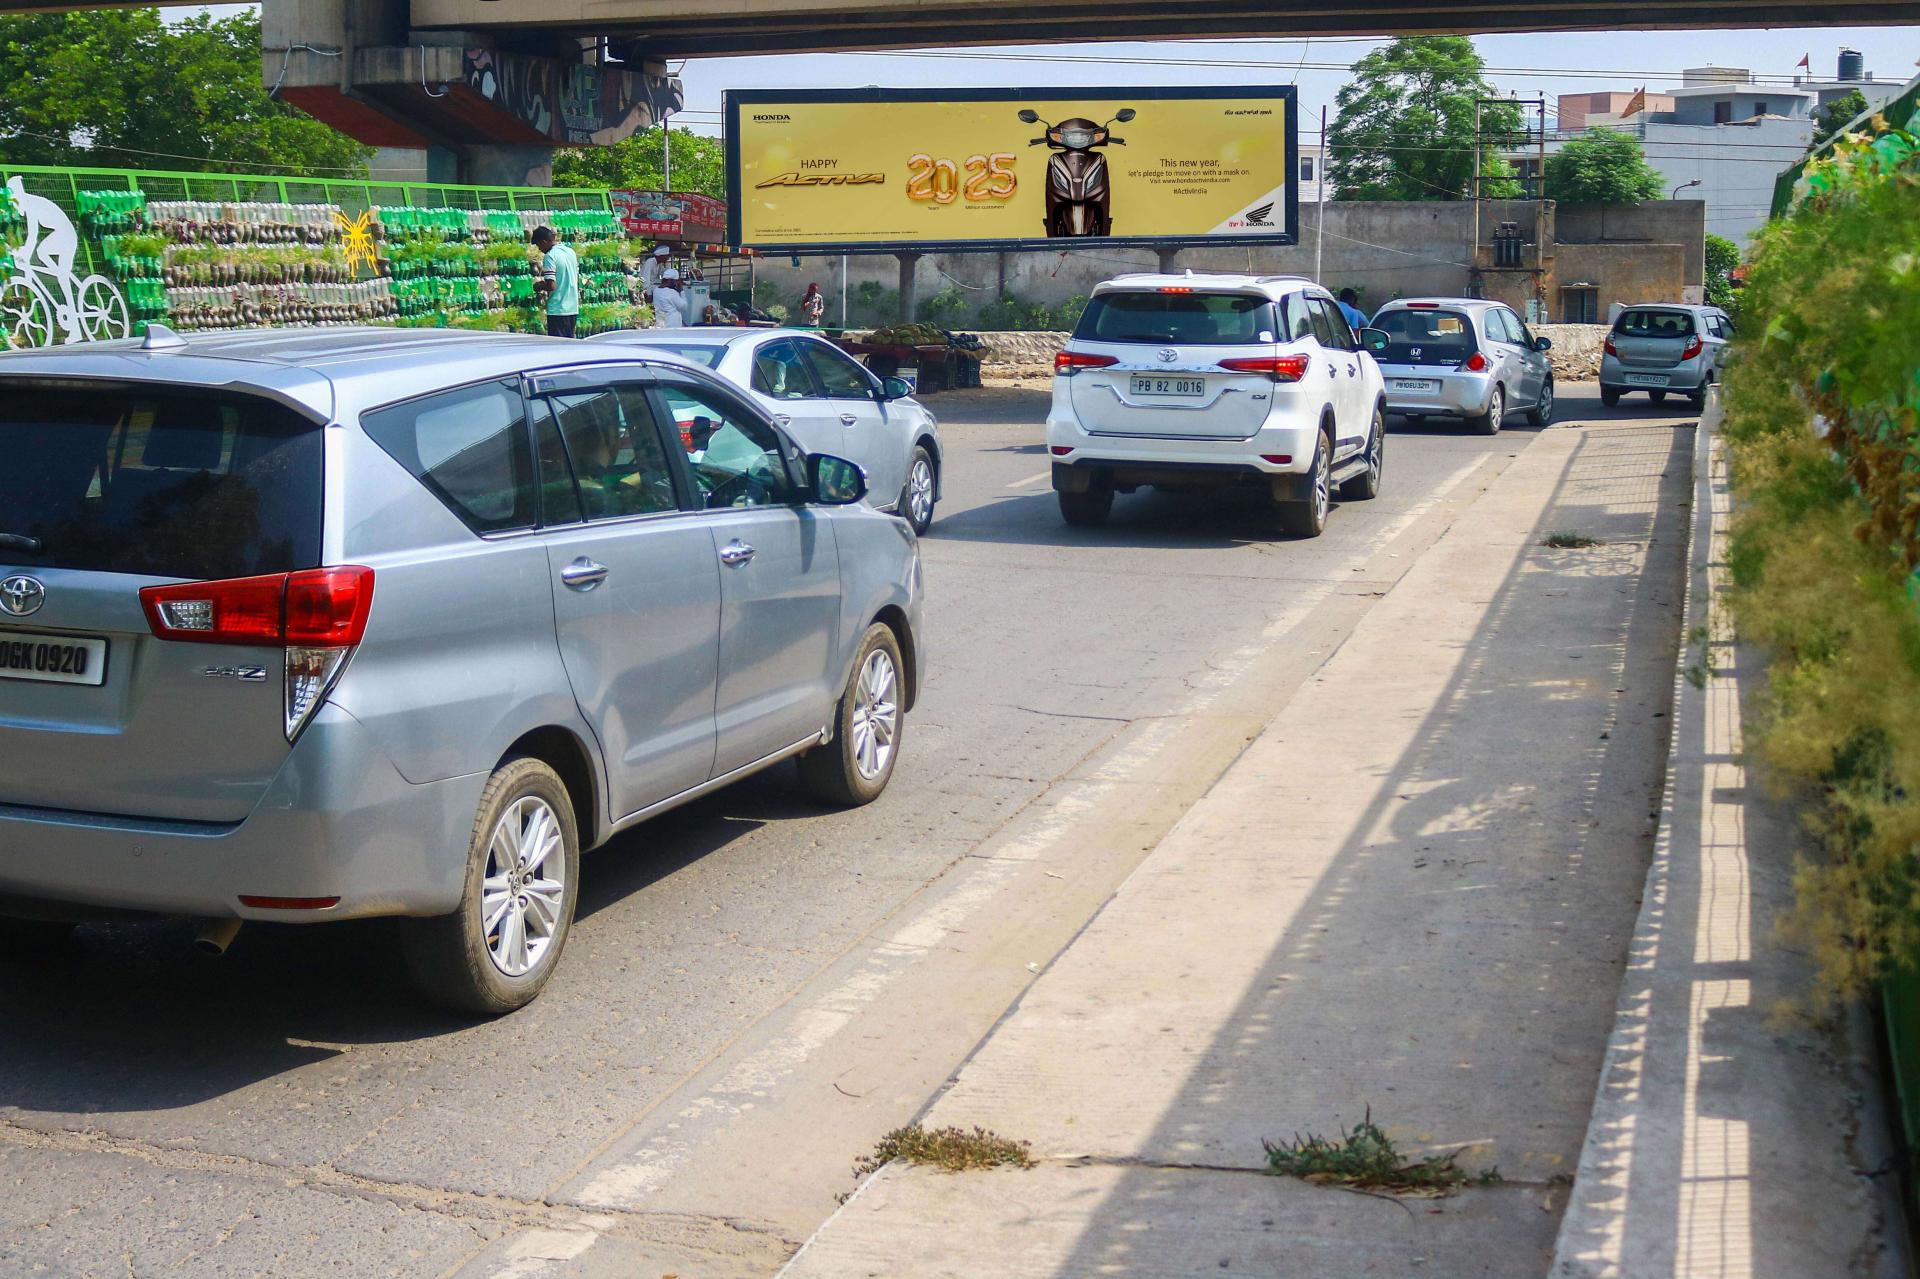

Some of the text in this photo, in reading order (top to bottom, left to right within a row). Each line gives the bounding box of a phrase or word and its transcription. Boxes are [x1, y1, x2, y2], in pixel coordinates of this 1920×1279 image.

[801, 159, 838, 169] HAPPY
[1160, 158, 1177, 167] This
[1199, 159, 1220, 168] year,
[1142, 169, 1164, 178] pledge
[755, 172, 885, 189] ACTIVA
[1138, 380, 1202, 393] PB 82 0016
